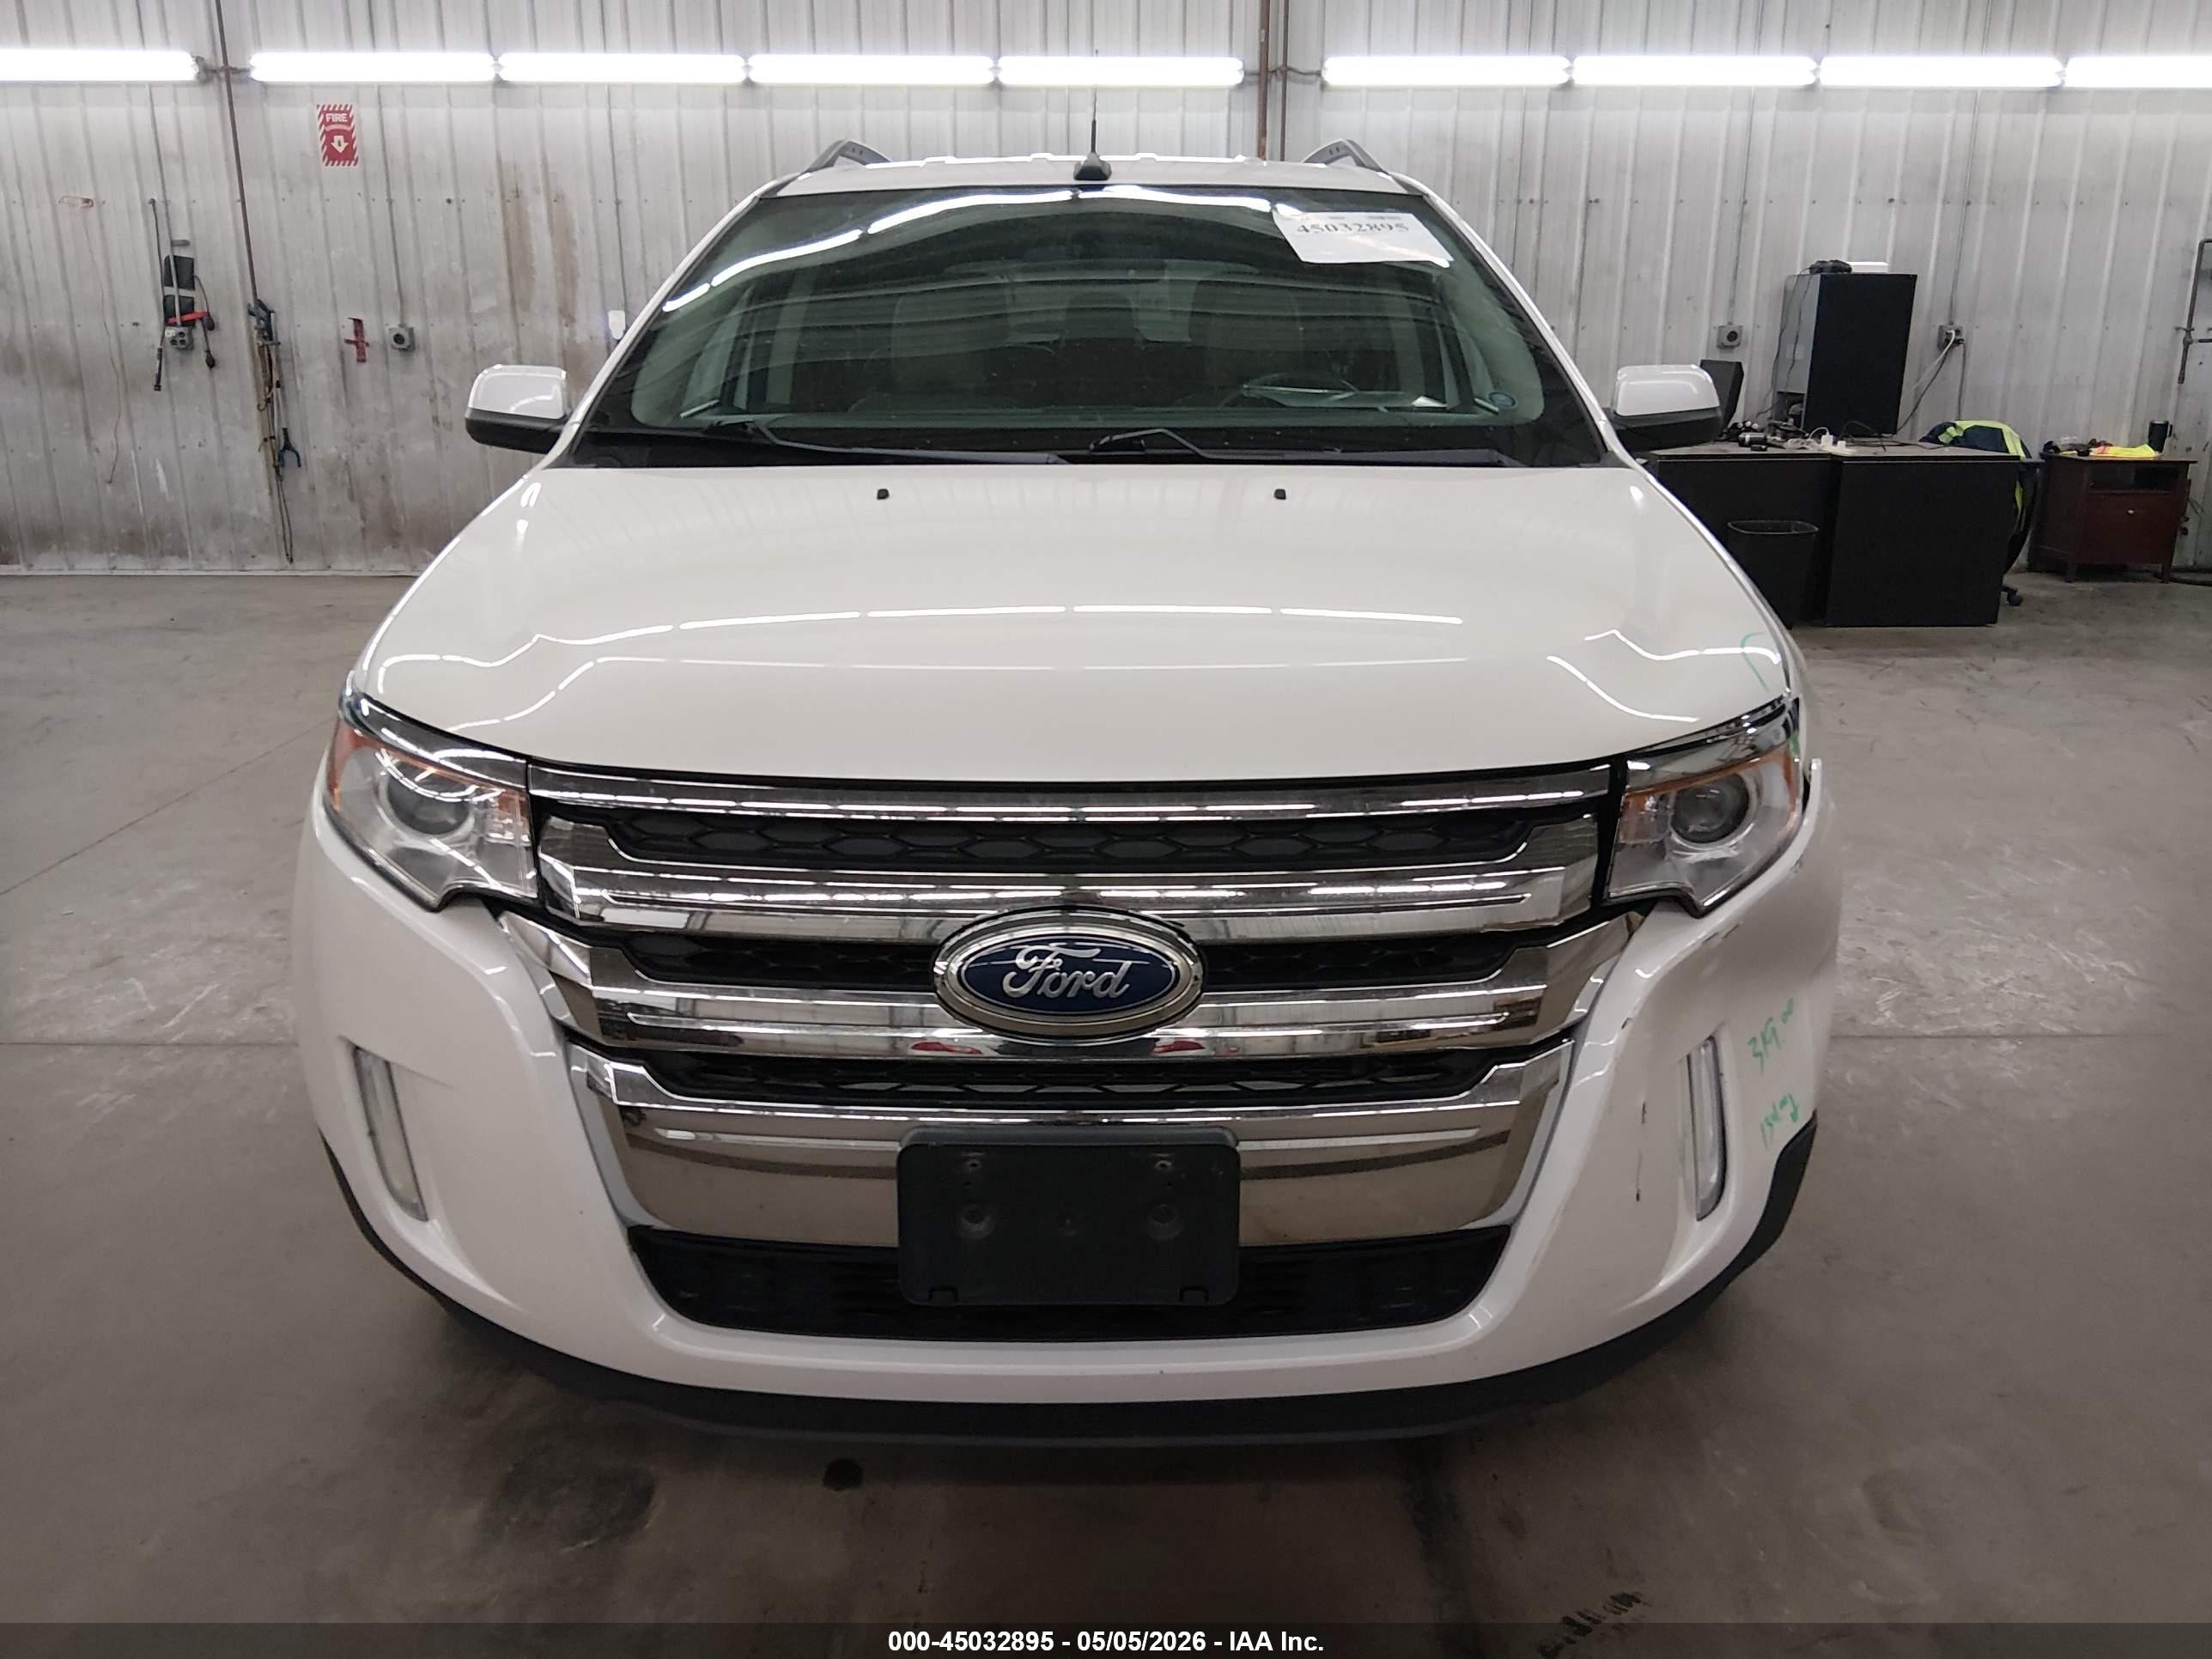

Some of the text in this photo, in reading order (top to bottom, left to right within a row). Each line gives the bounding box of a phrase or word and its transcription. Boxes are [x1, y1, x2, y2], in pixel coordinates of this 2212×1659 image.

[325, 112, 348, 123] FIRE
[1297, 222, 1409, 234] 45032895
[1003, 945, 1133, 999] Ford
